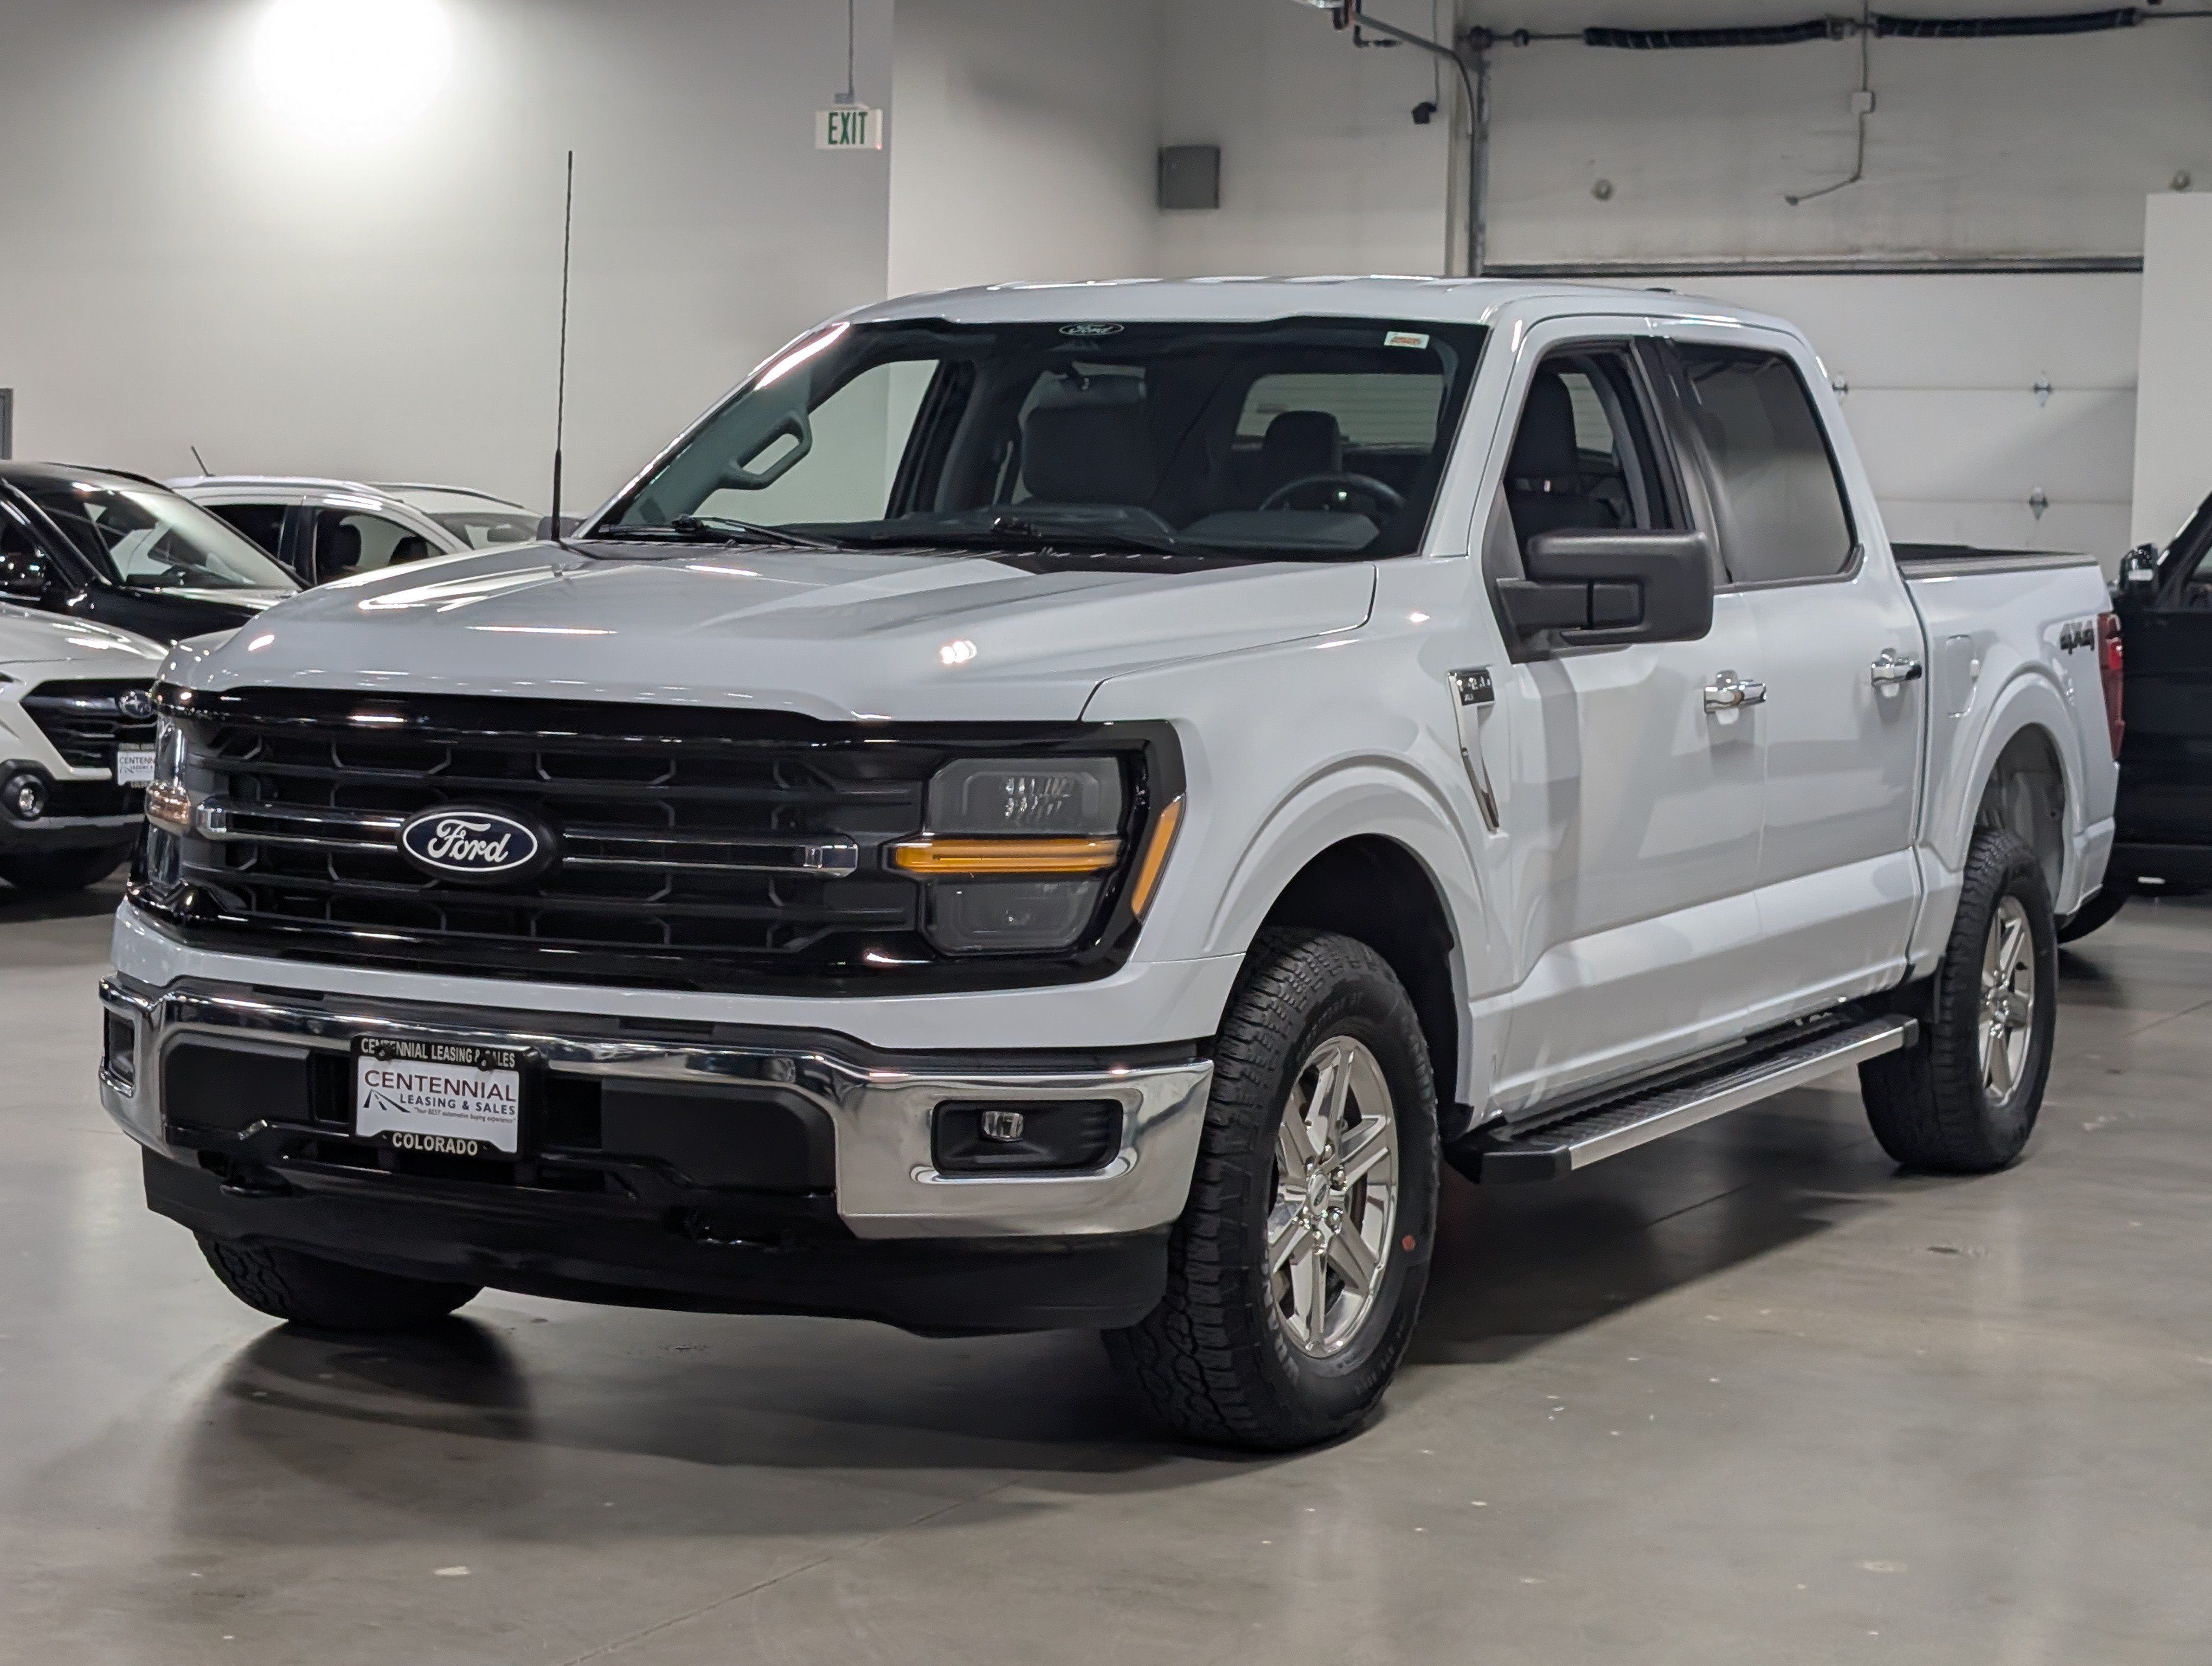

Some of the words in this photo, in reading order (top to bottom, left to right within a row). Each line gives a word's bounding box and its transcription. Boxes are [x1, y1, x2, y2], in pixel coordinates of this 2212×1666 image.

[828, 112, 867, 144] EXIT
[427, 819, 511, 862] Ford
[432, 1044, 472, 1063] LEASING
[485, 1050, 516, 1068] LES
[364, 1069, 516, 1102] CENTENNIAL
[400, 1093, 456, 1109] LEASING
[462, 1100, 469, 1110] &
[475, 1101, 516, 1116] SALES
[393, 1132, 478, 1156] COLORADO
